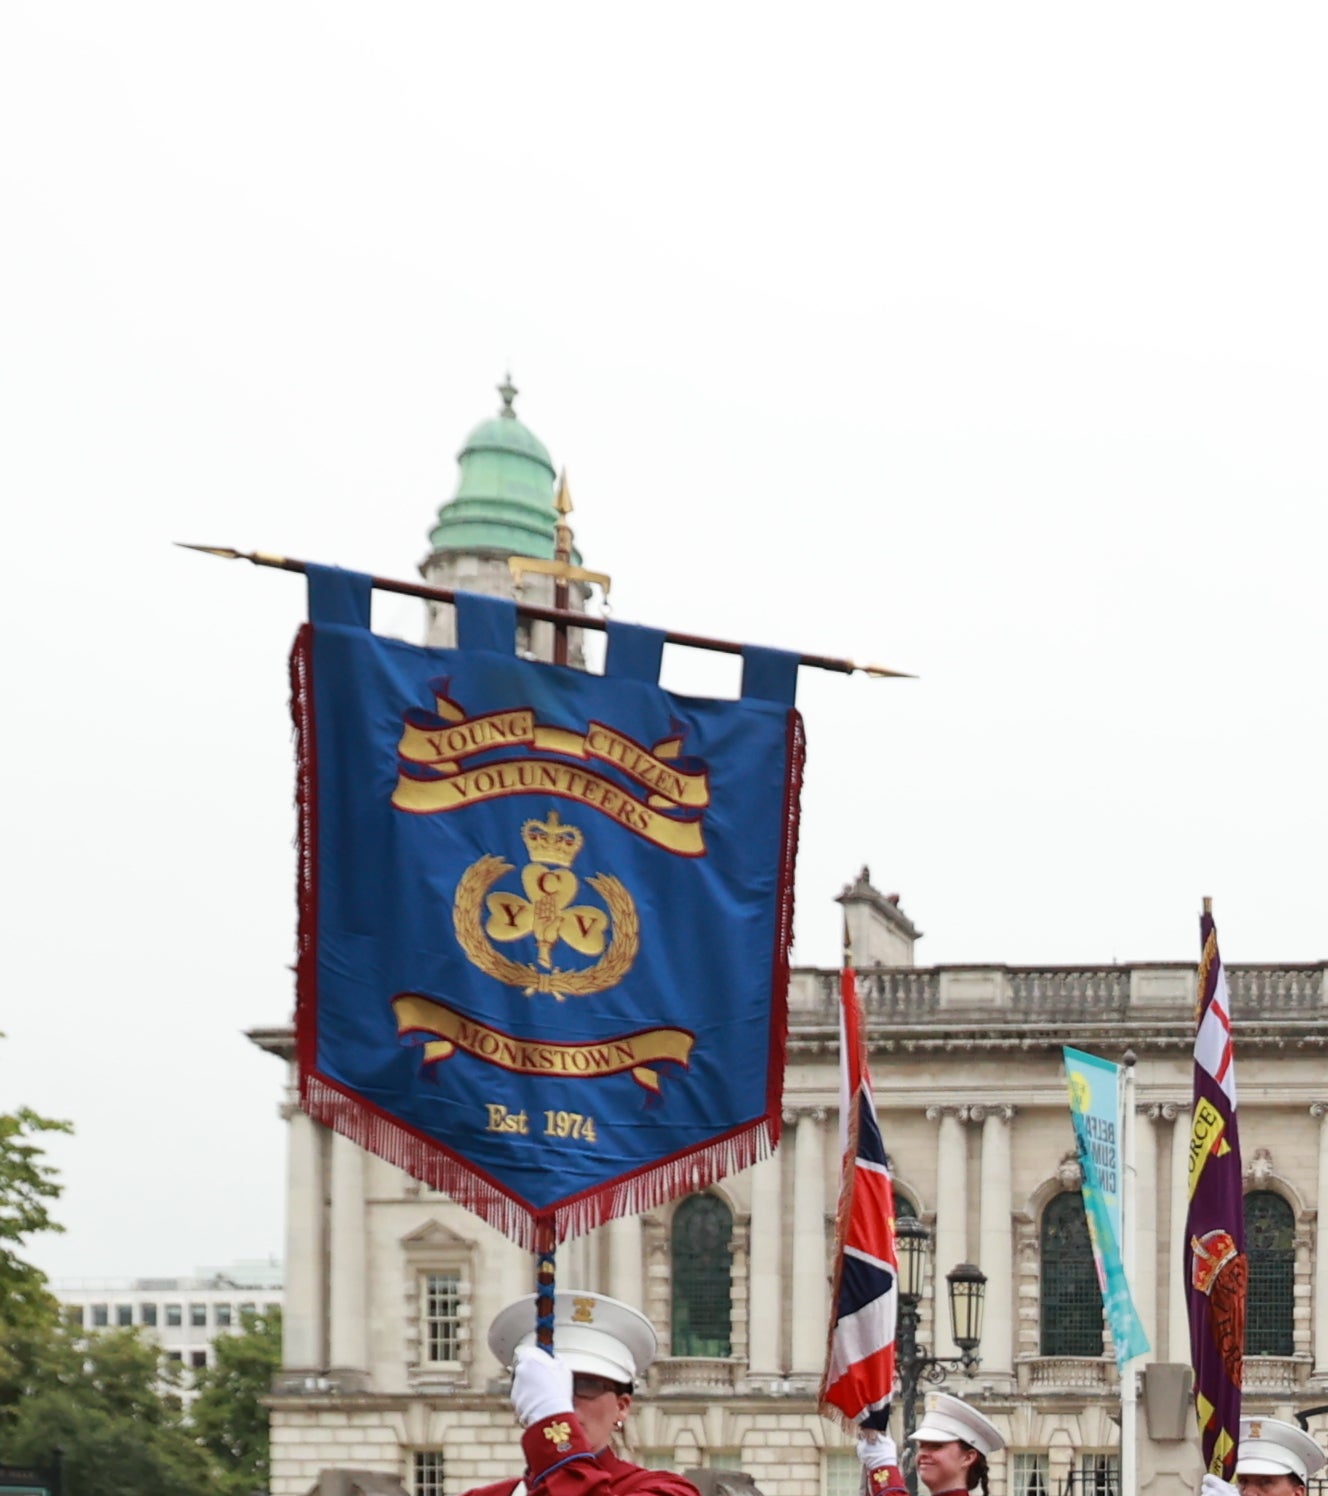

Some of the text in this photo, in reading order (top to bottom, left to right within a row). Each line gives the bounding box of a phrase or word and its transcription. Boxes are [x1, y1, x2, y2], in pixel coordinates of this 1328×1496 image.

[426, 716, 690, 798] YOUNG CITIZEN
[450, 767, 653, 832] VOLUNTEERS
[537, 871, 562, 896] C
[455, 1021, 636, 1071] MONKSTOWN
[485, 1103, 597, 1143] Est 1974
